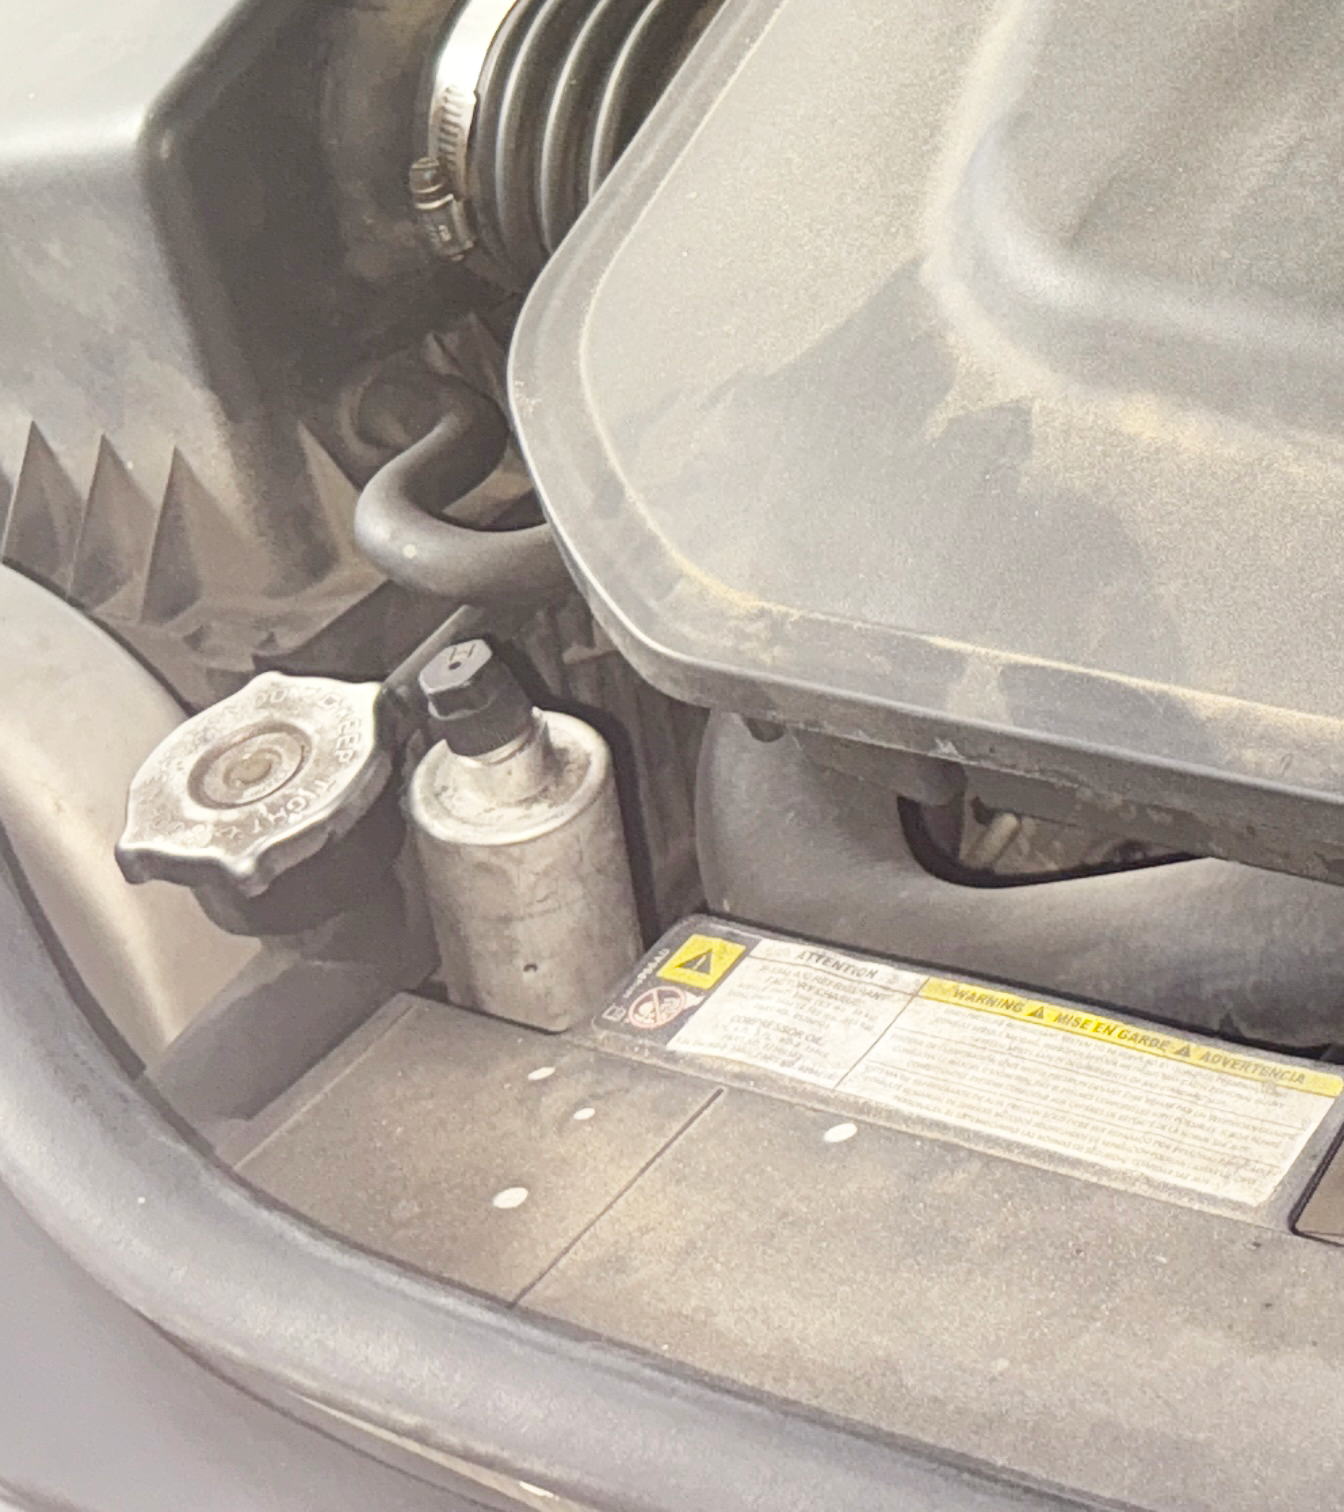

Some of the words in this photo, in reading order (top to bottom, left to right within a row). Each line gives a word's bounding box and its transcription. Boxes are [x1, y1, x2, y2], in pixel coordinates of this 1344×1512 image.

[793, 948, 879, 980] ATTENTION
[951, 987, 1027, 1015] WARNING
[1053, 1011, 1094, 1031] MISE
[1094, 1018, 1116, 1037] EN
[1116, 1023, 1173, 1052] GARDE
[1199, 1050, 1307, 1086] ADVERTENCIA
